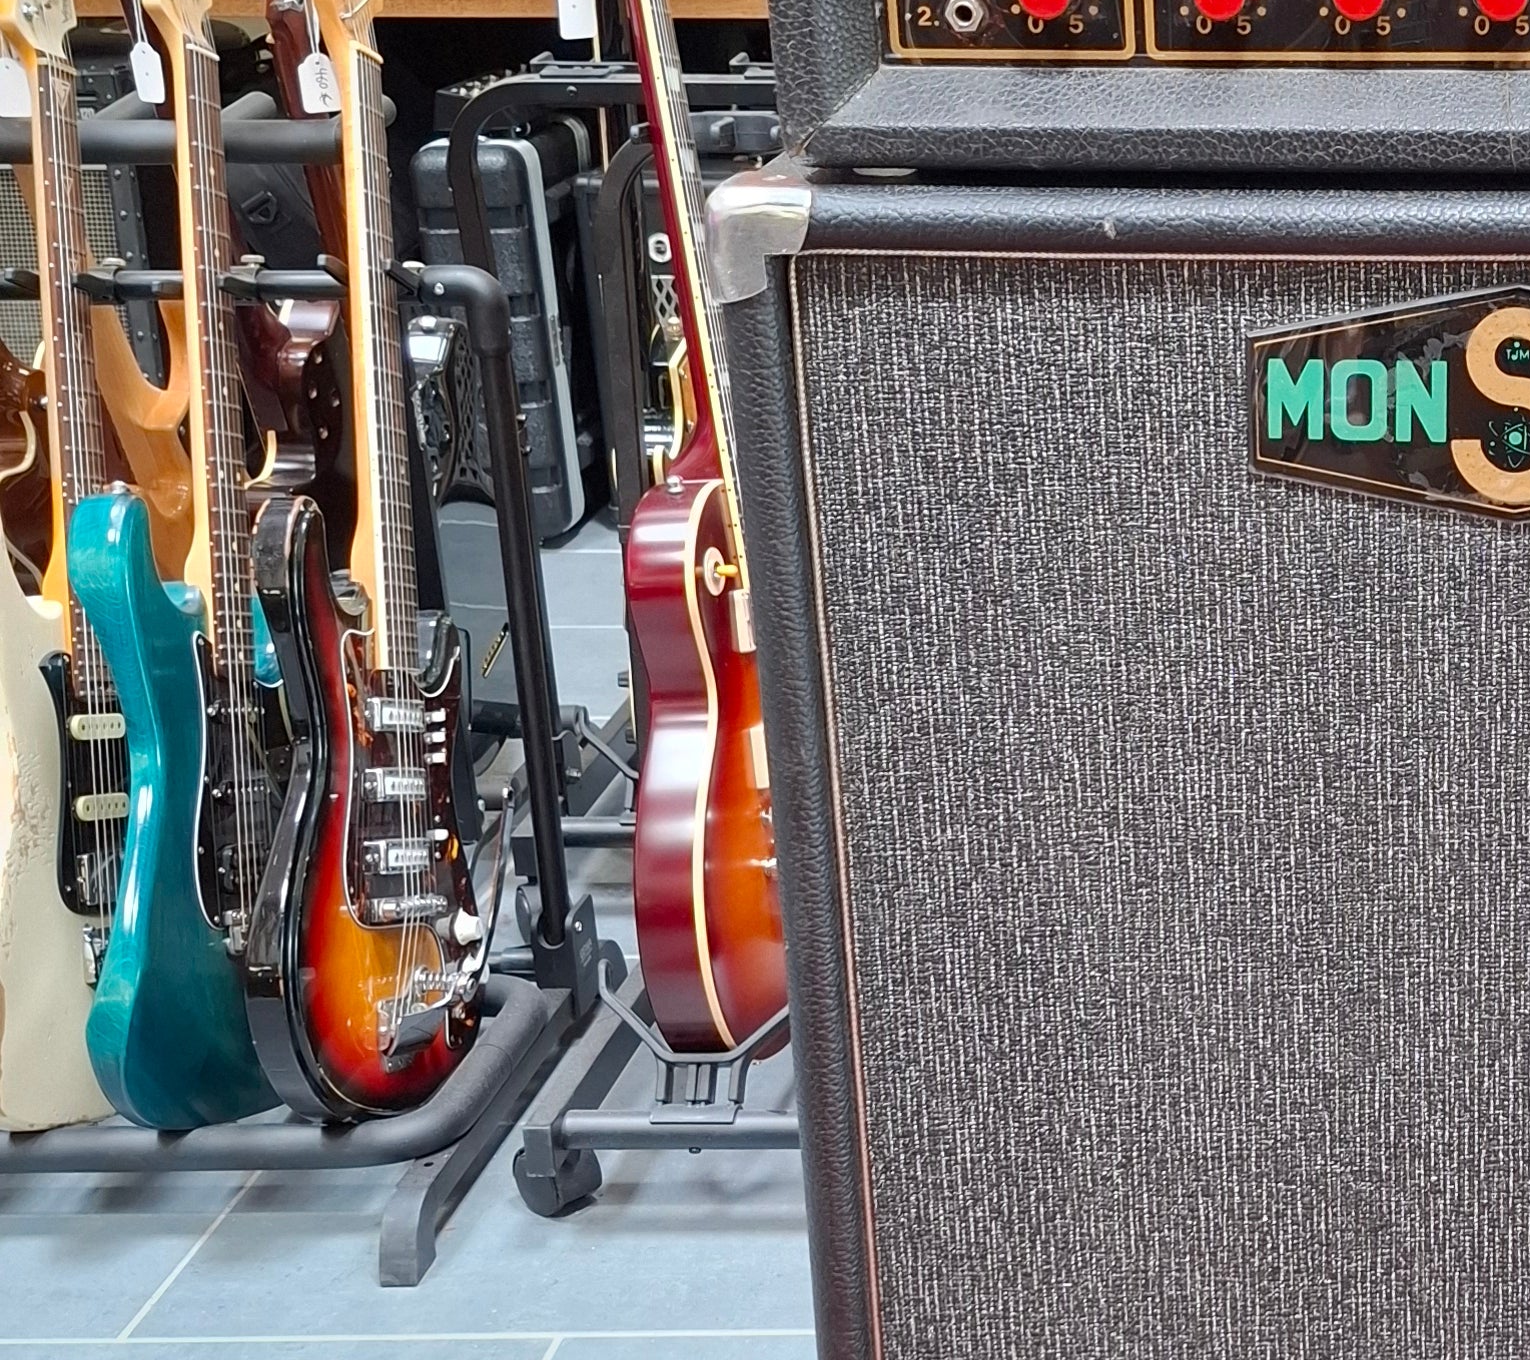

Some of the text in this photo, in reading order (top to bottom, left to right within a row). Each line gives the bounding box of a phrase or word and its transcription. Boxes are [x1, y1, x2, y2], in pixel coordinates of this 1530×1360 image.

[917, 6, 939, 27] 2.
[1027, 16, 1044, 34] 0
[1069, 15, 1084, 34] 5
[1196, 15, 1212, 35] 0
[1236, 16, 1252, 35] 5
[1334, 16, 1350, 35] 0
[1376, 16, 1391, 35] 5
[1474, 15, 1490, 36] 0
[1515, 15, 1530, 35] 5
[315, 68, 328, 89] 460
[1506, 345, 1529, 361] TJM
